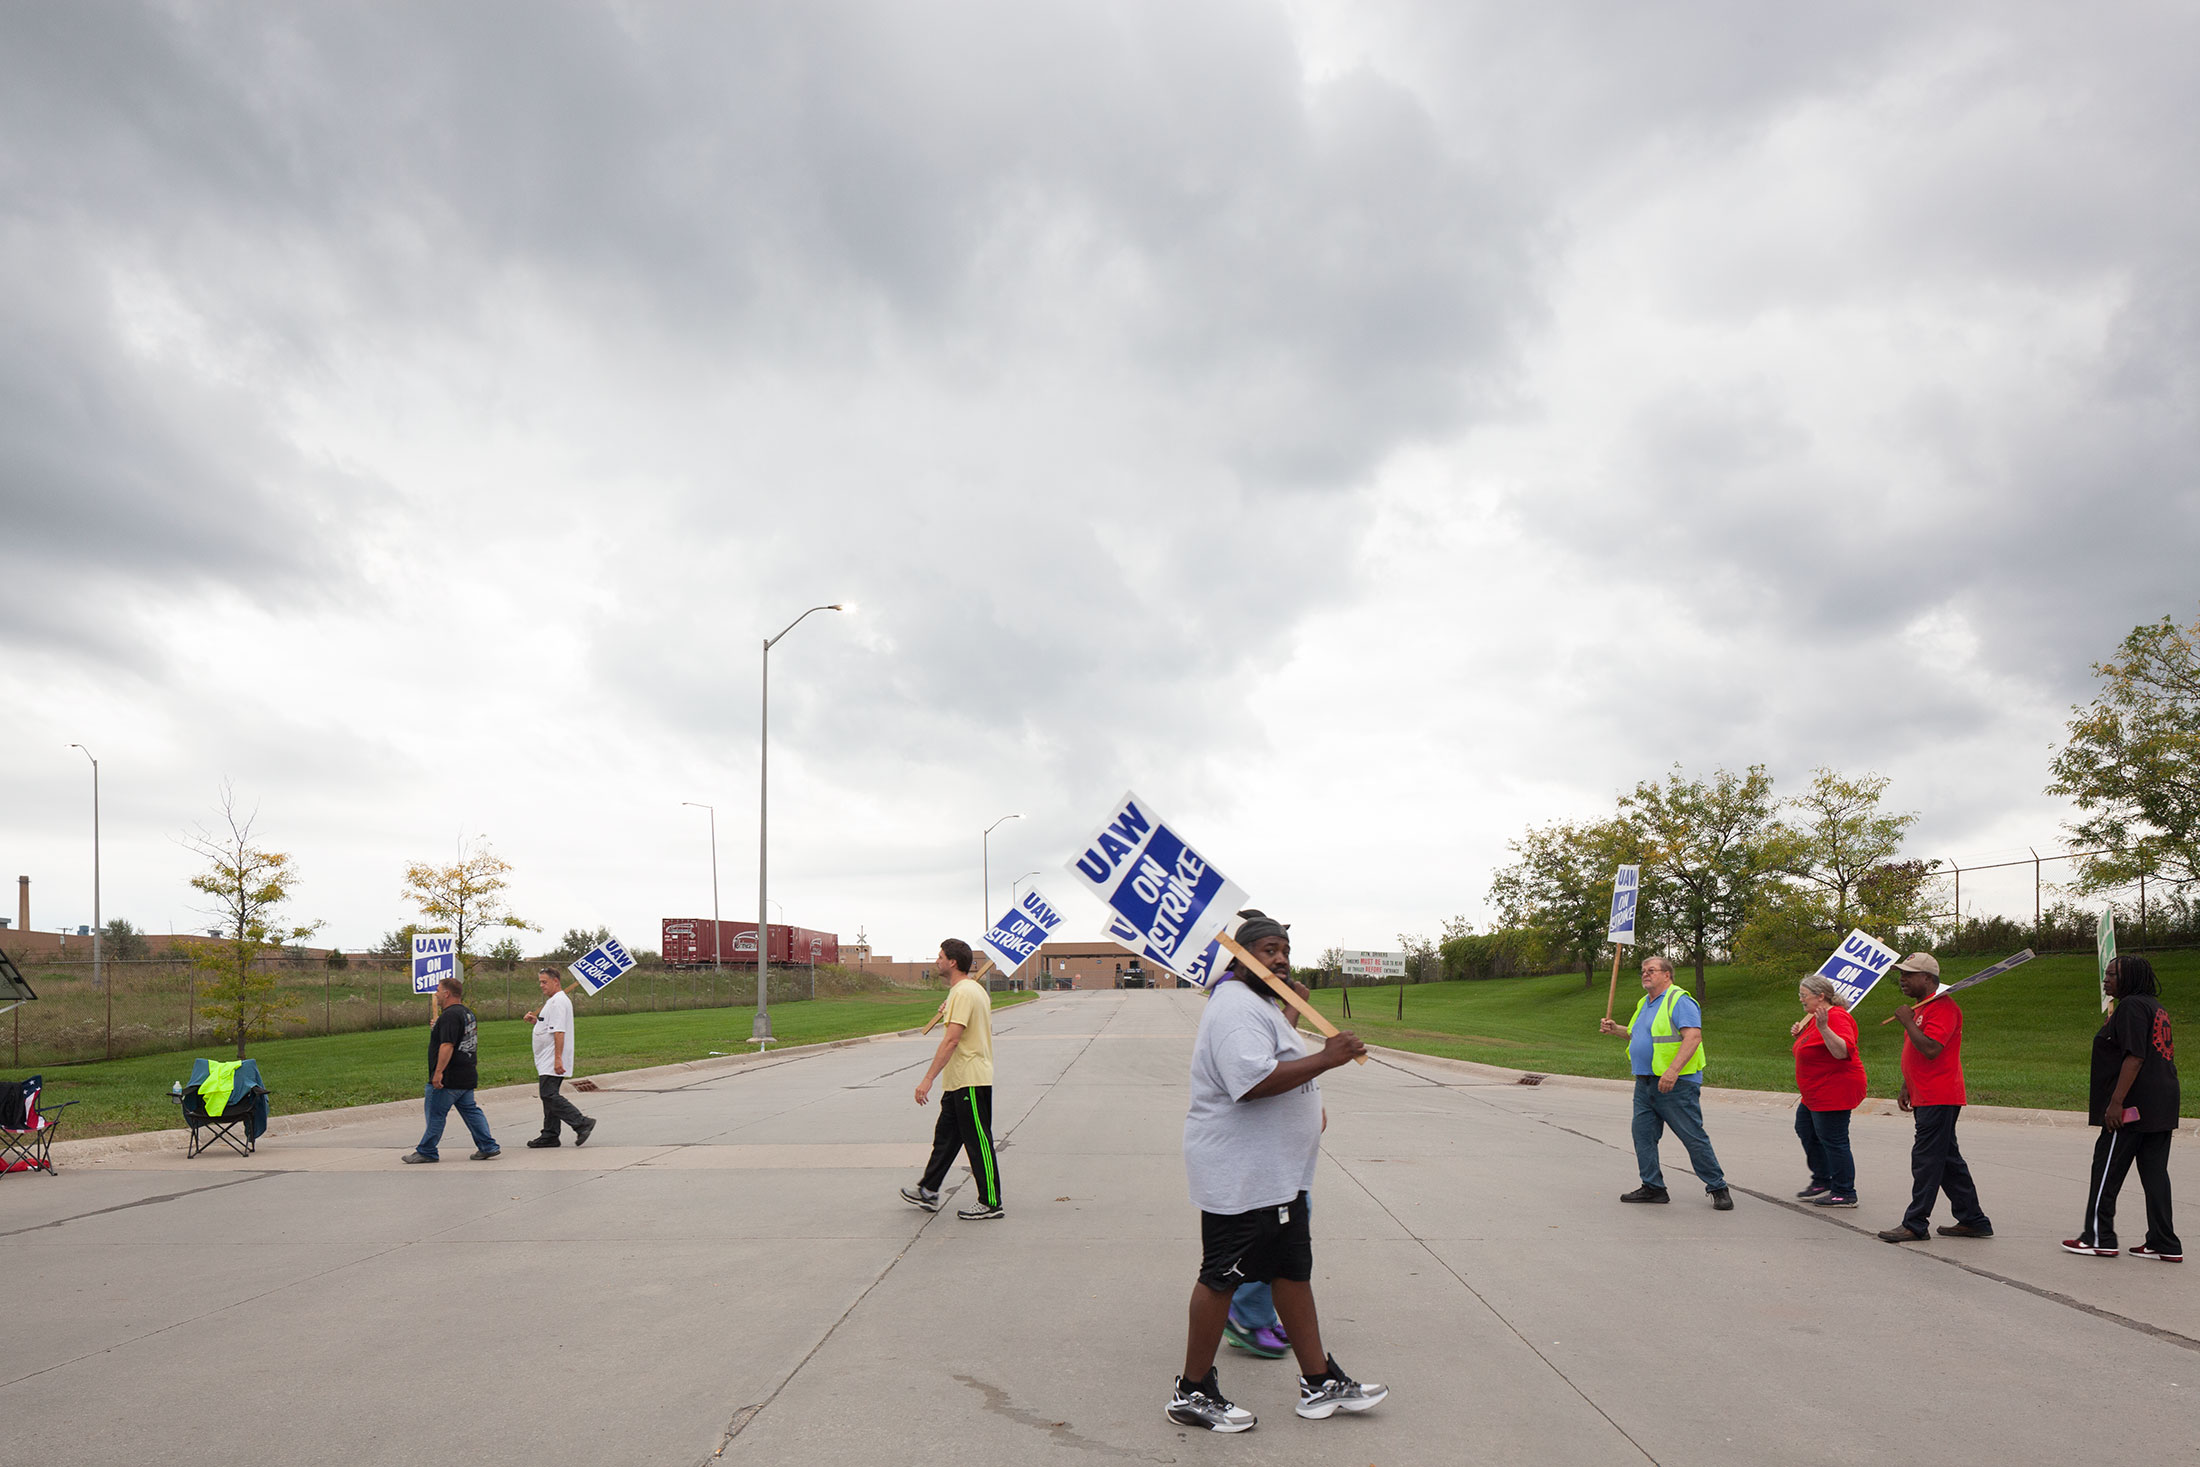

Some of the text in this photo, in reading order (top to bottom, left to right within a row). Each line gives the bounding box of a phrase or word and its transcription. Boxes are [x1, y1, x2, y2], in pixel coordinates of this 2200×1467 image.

[1076, 801, 1151, 885] UAW
[1132, 854, 1168, 905] ON
[1618, 869, 1638, 887] UAW
[1023, 891, 1061, 930] UAW
[1148, 846, 1206, 955] STRIKE
[1618, 892, 1630, 911] ON
[1010, 919, 1031, 937] ON
[1610, 905, 1635, 931] STRIKE
[416, 939, 452, 953] UAW
[605, 939, 633, 967] UAW
[984, 926, 1037, 956] STRIKE
[1844, 935, 1892, 971] UAW
[427, 957, 441, 973] ON
[575, 959, 613, 984] STRIKE
[594, 957, 613, 971] ON
[1836, 965, 1863, 983] ON
[416, 969, 452, 990] STRIKE
